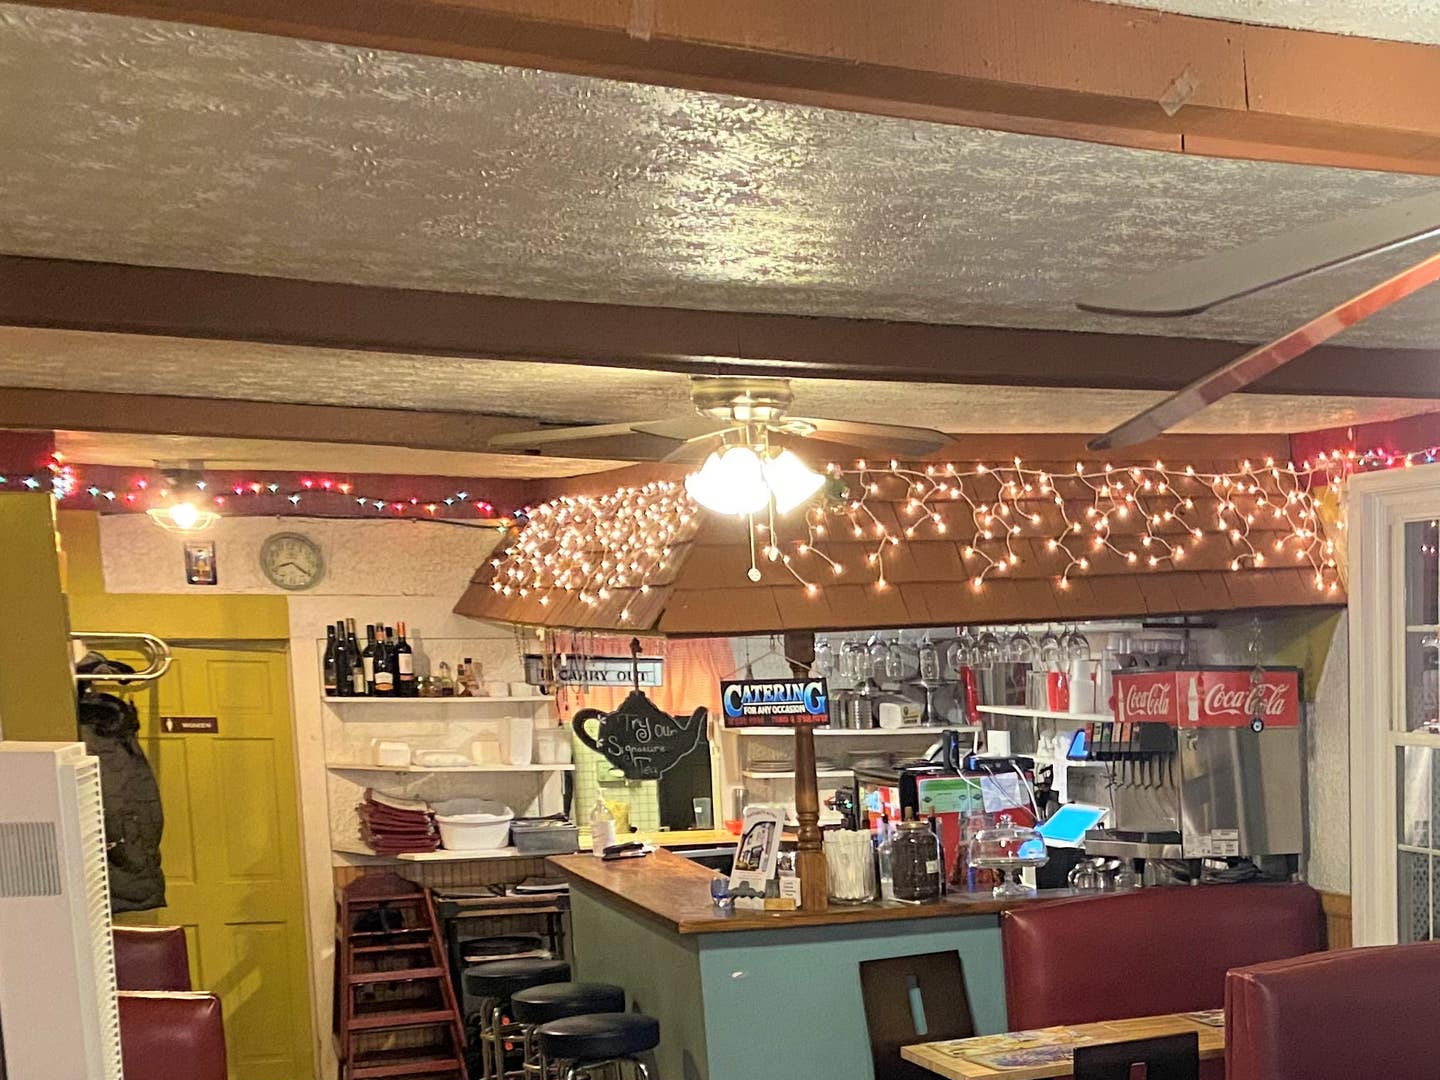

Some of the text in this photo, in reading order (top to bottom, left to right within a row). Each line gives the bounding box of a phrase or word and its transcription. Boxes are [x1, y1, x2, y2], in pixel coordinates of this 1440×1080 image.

[724, 682, 826, 717] CATERING
[743, 704, 806, 715] FOR ANY OCCASION
[1126, 683, 1171, 716] Coca-Cola
[620, 713, 652, 744] Try
